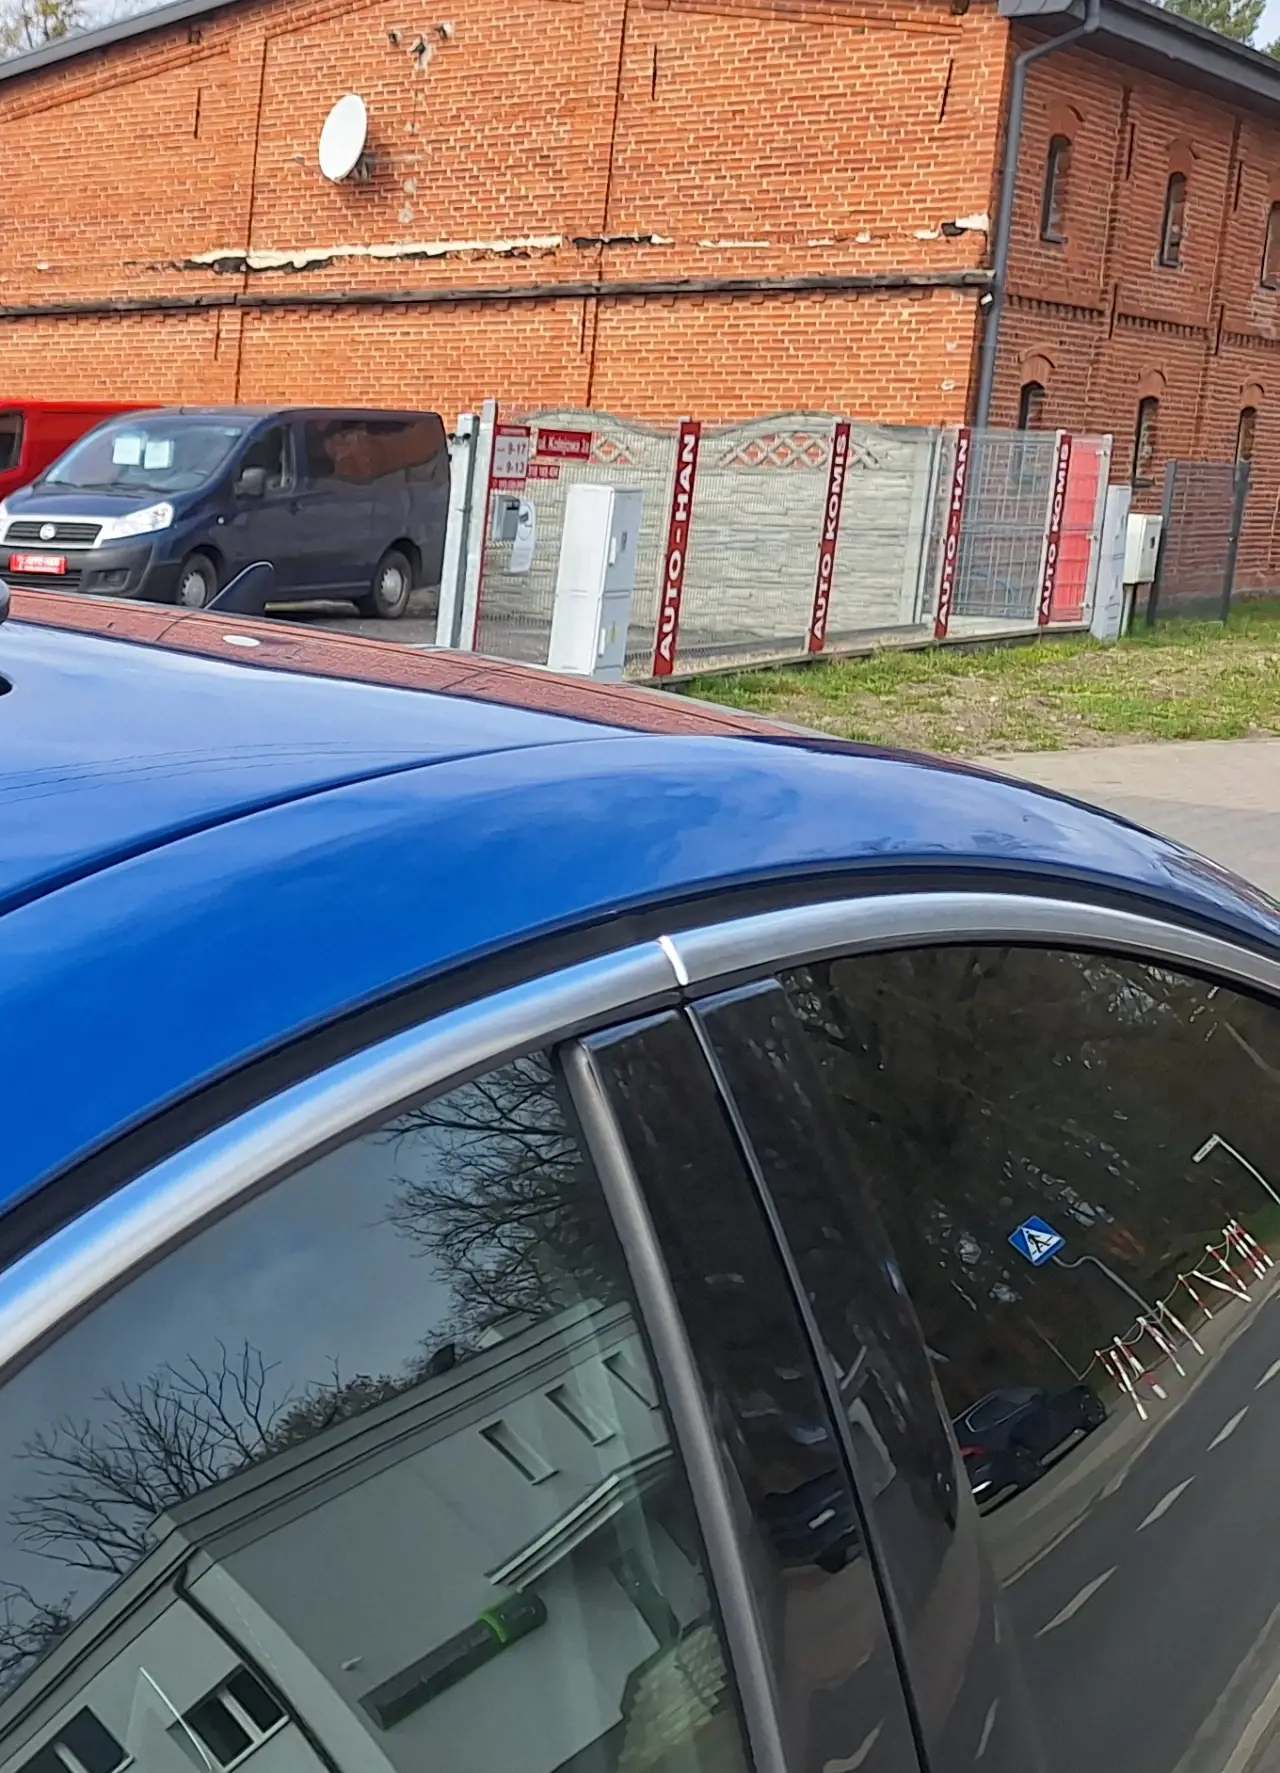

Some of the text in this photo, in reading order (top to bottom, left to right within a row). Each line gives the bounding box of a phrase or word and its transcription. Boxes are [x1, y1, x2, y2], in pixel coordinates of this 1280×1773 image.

[813, 434, 848, 641] AUTO KOMIS
[1041, 443, 1069, 616] AUTO KOMIS
